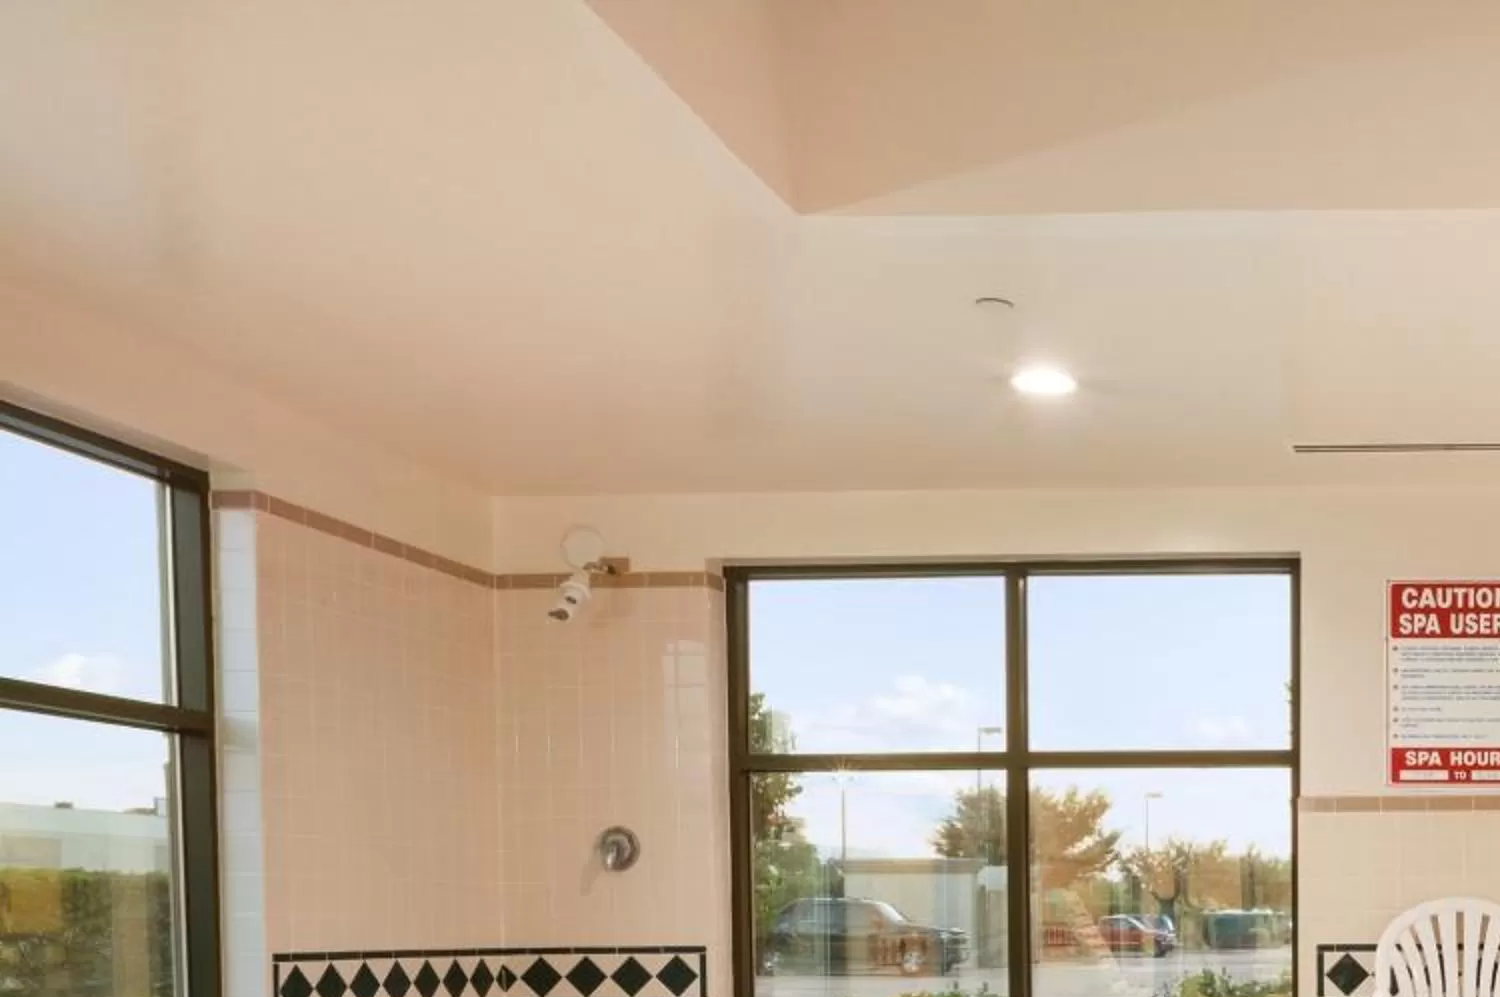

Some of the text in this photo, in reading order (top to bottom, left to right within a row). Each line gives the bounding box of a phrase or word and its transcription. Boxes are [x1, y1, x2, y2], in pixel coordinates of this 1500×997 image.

[1399, 613, 1441, 635] SPA
[1404, 751, 1443, 767] SPA
[1453, 771, 1467, 780] TO
